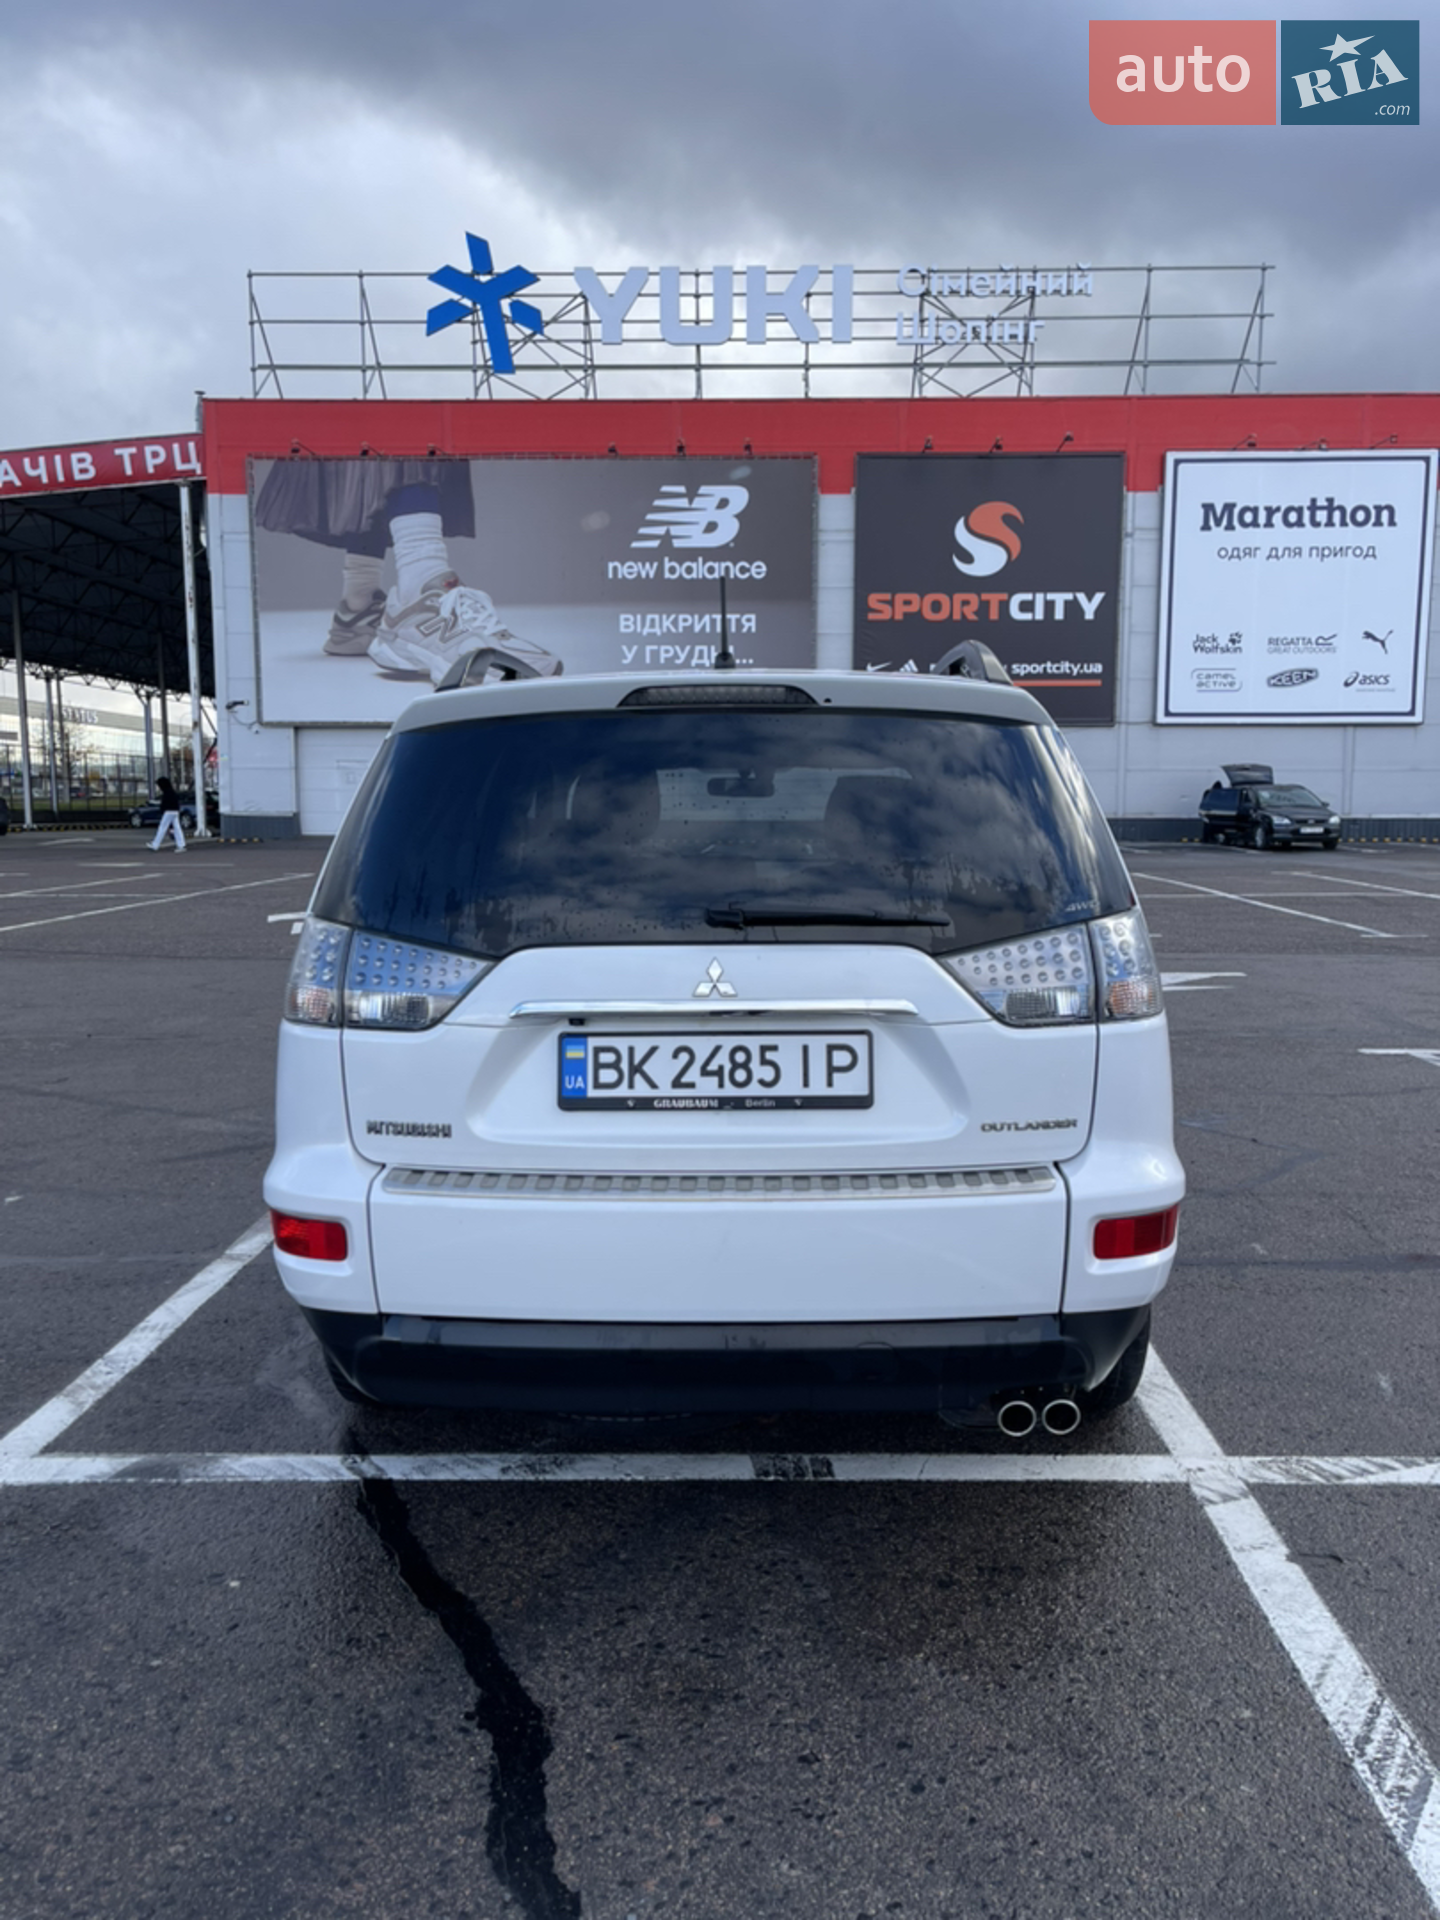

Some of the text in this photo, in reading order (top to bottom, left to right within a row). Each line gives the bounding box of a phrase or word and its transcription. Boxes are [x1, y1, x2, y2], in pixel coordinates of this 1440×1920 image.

[896, 261, 1093, 298] Сімейний
[573, 264, 854, 346] YUKI
[896, 312, 1046, 346] Шопінг
[114, 441, 202, 476] ТРЦ
[1199, 497, 1398, 532] Marathon
[1216, 544, 1378, 562] одяг для пригод
[607, 556, 768, 580] new balance
[867, 591, 1107, 622] SPORTCITY
[618, 613, 758, 637] ВІДКРИТТЯ
[1195, 632, 1219, 643] Jack
[1267, 637, 1313, 647] REGATTA
[621, 645, 639, 664] У
[1192, 643, 1243, 654] Wolfskin
[1011, 659, 1104, 677] sportcity.ua
[1270, 669, 1317, 686] KEEN
[592, 1043, 859, 1090] BK 2485 IP
[565, 1074, 585, 1089] UA
[745, 1098, 776, 1108] Berlin
[980, 1119, 1078, 1133] OUTLANDER
